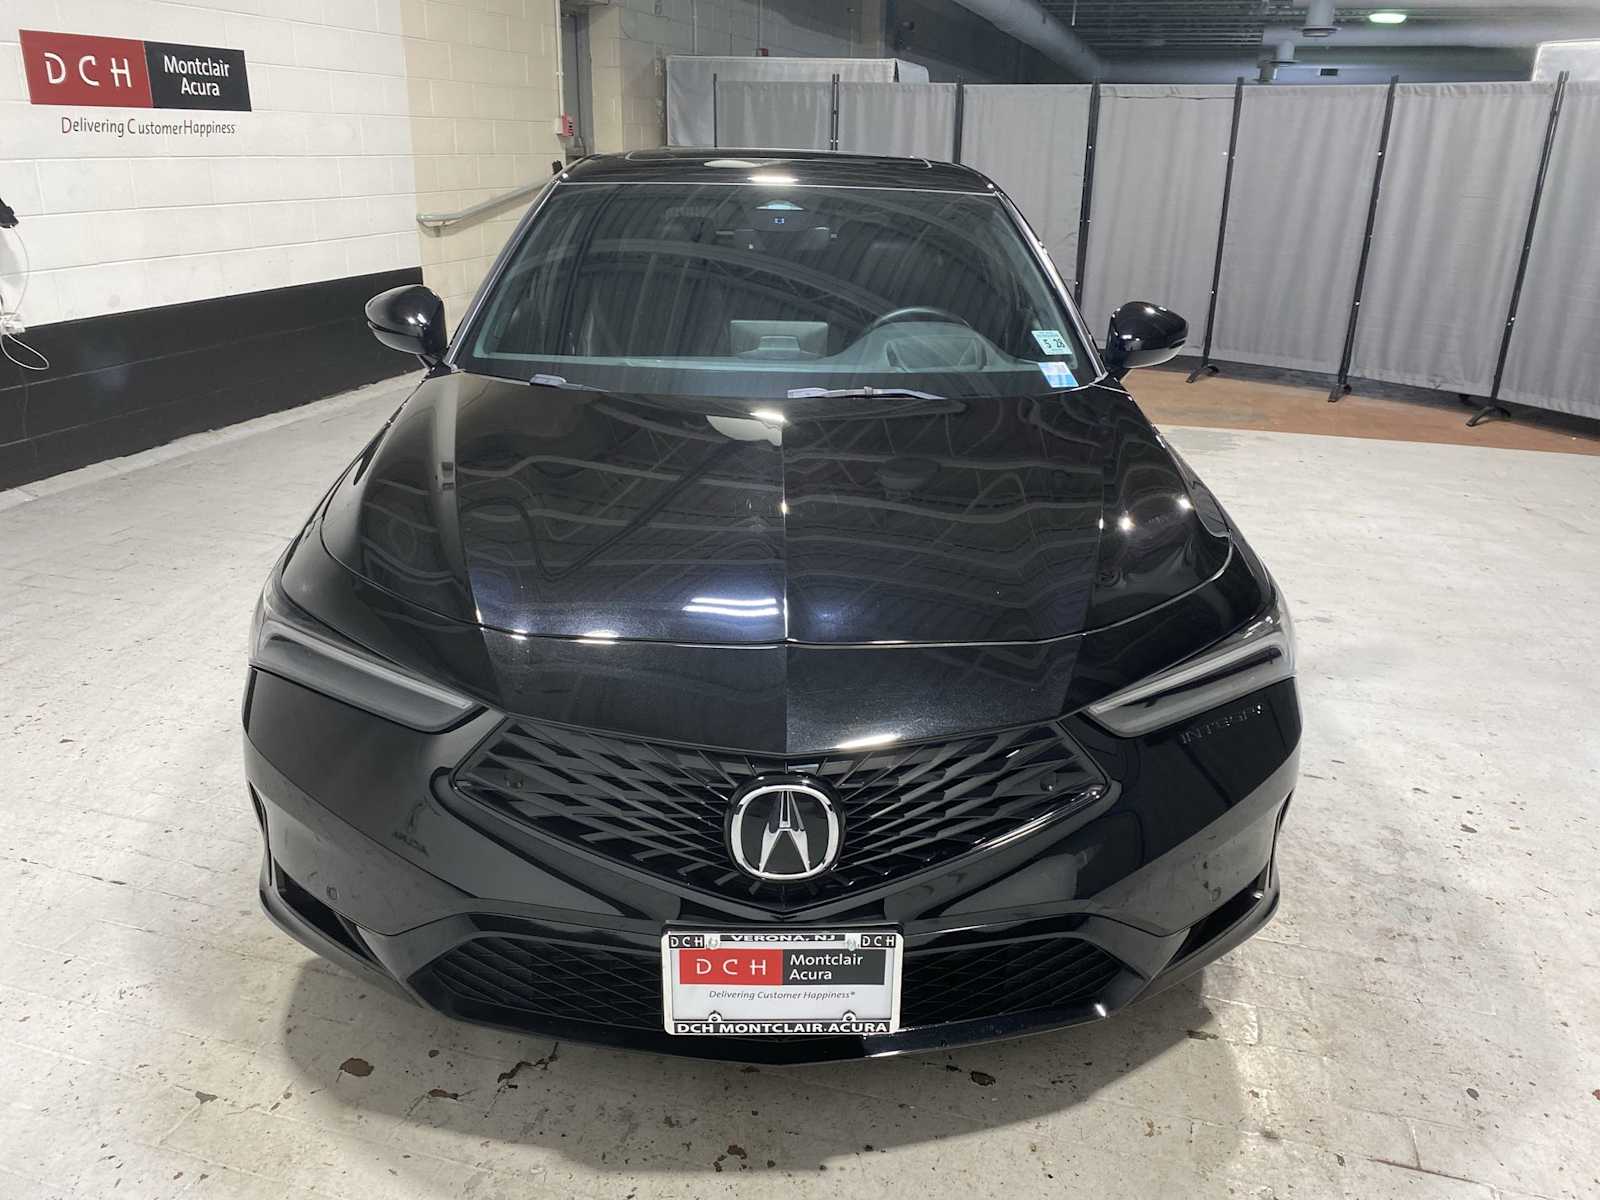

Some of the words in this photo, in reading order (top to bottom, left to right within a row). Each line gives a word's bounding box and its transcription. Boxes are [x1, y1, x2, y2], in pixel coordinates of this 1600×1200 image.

[164, 55, 230, 78] Montclair
[181, 78, 221, 97] Acura
[61, 116, 124, 138] Delivering
[127, 118, 183, 136] Customer
[184, 119, 236, 138] Happiness
[670, 936, 704, 948] DCH
[731, 934, 811, 942] VERONA,
[814, 934, 836, 942] NJ
[862, 935, 895, 947] DCH
[696, 958, 767, 976] DCH
[790, 954, 864, 967] Montclair
[789, 968, 833, 981] Acura
[709, 990, 755, 1001] Delivering
[757, 991, 801, 1000] Customer
[677, 1023, 714, 1033] DCH
